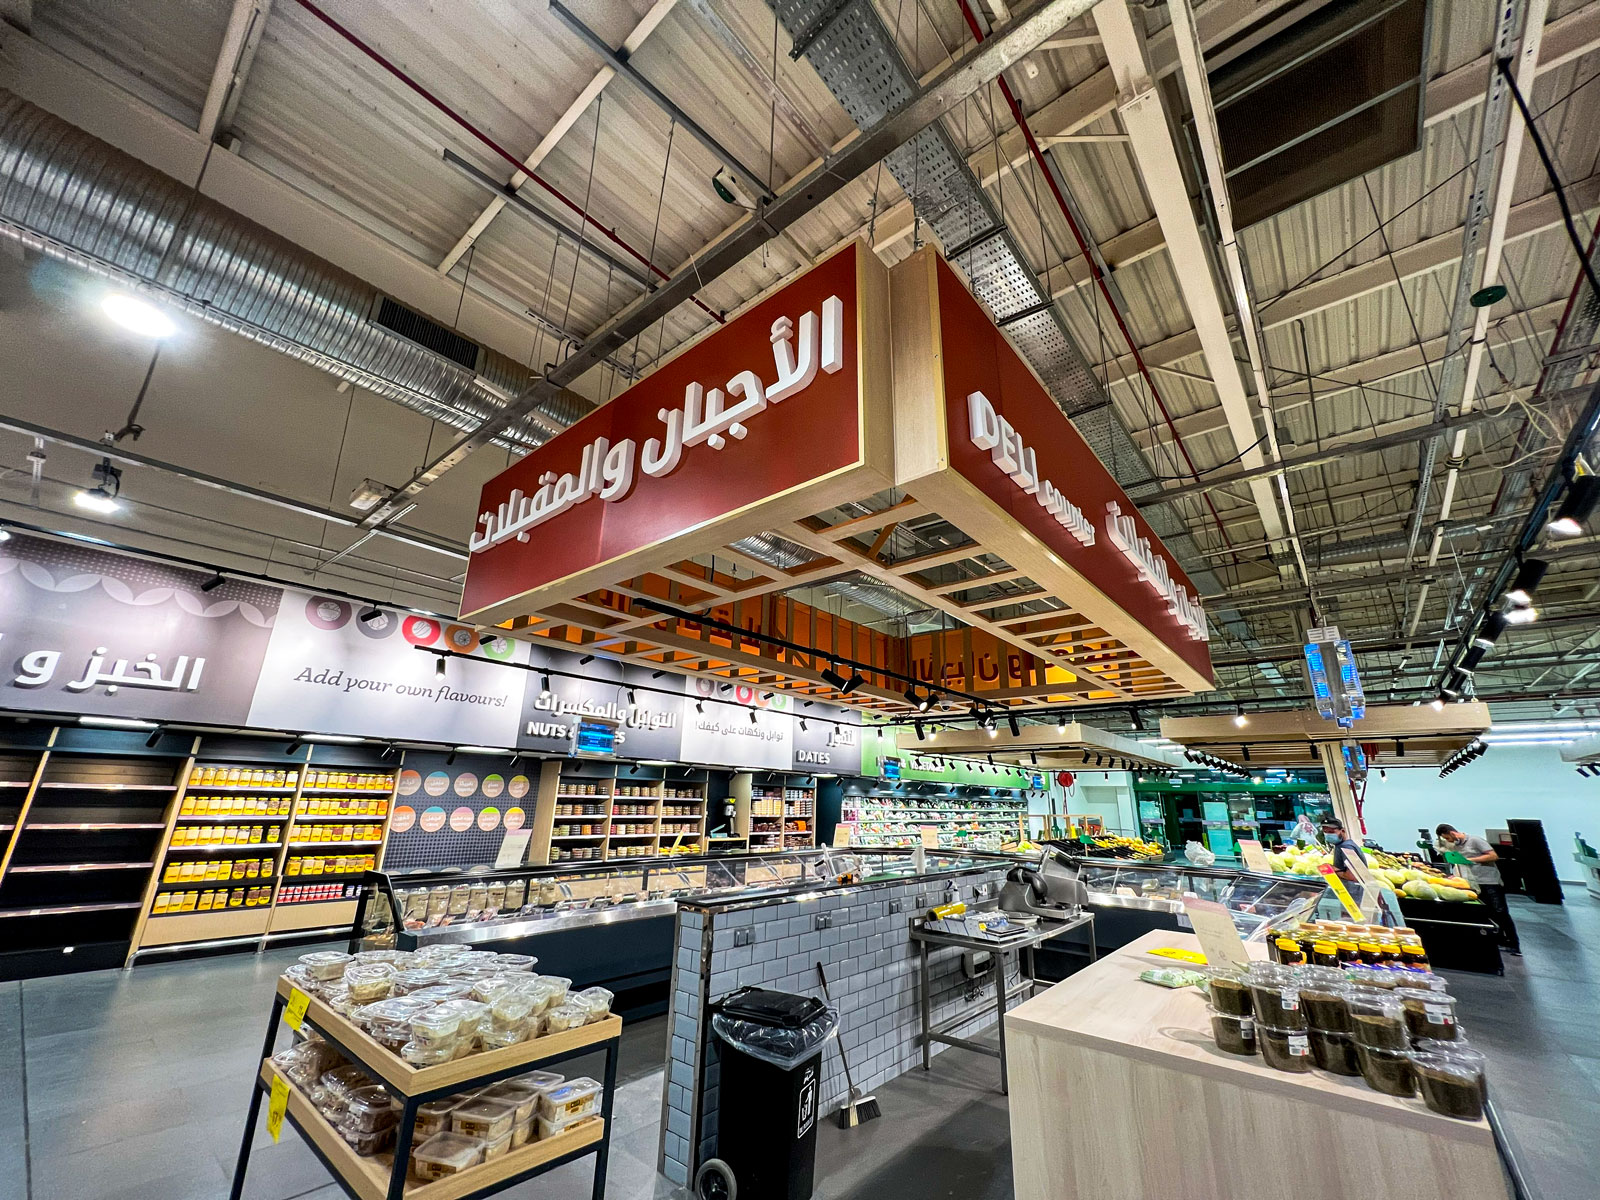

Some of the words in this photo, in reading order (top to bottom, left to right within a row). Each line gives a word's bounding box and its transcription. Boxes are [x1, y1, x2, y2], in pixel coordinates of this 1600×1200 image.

[642, 294, 844, 477] الأجبان
[967, 390, 1039, 494] DELI
[469, 436, 636, 553] والمقبلات
[66, 646, 206, 695] الخبز
[294, 666, 344, 686] Add
[343, 675, 393, 692] your
[396, 682, 433, 698] own
[434, 685, 509, 708] flavours!
[527, 721, 567, 738] NUTS
[721, 724, 736, 735] على
[797, 750, 830, 764] DATES
